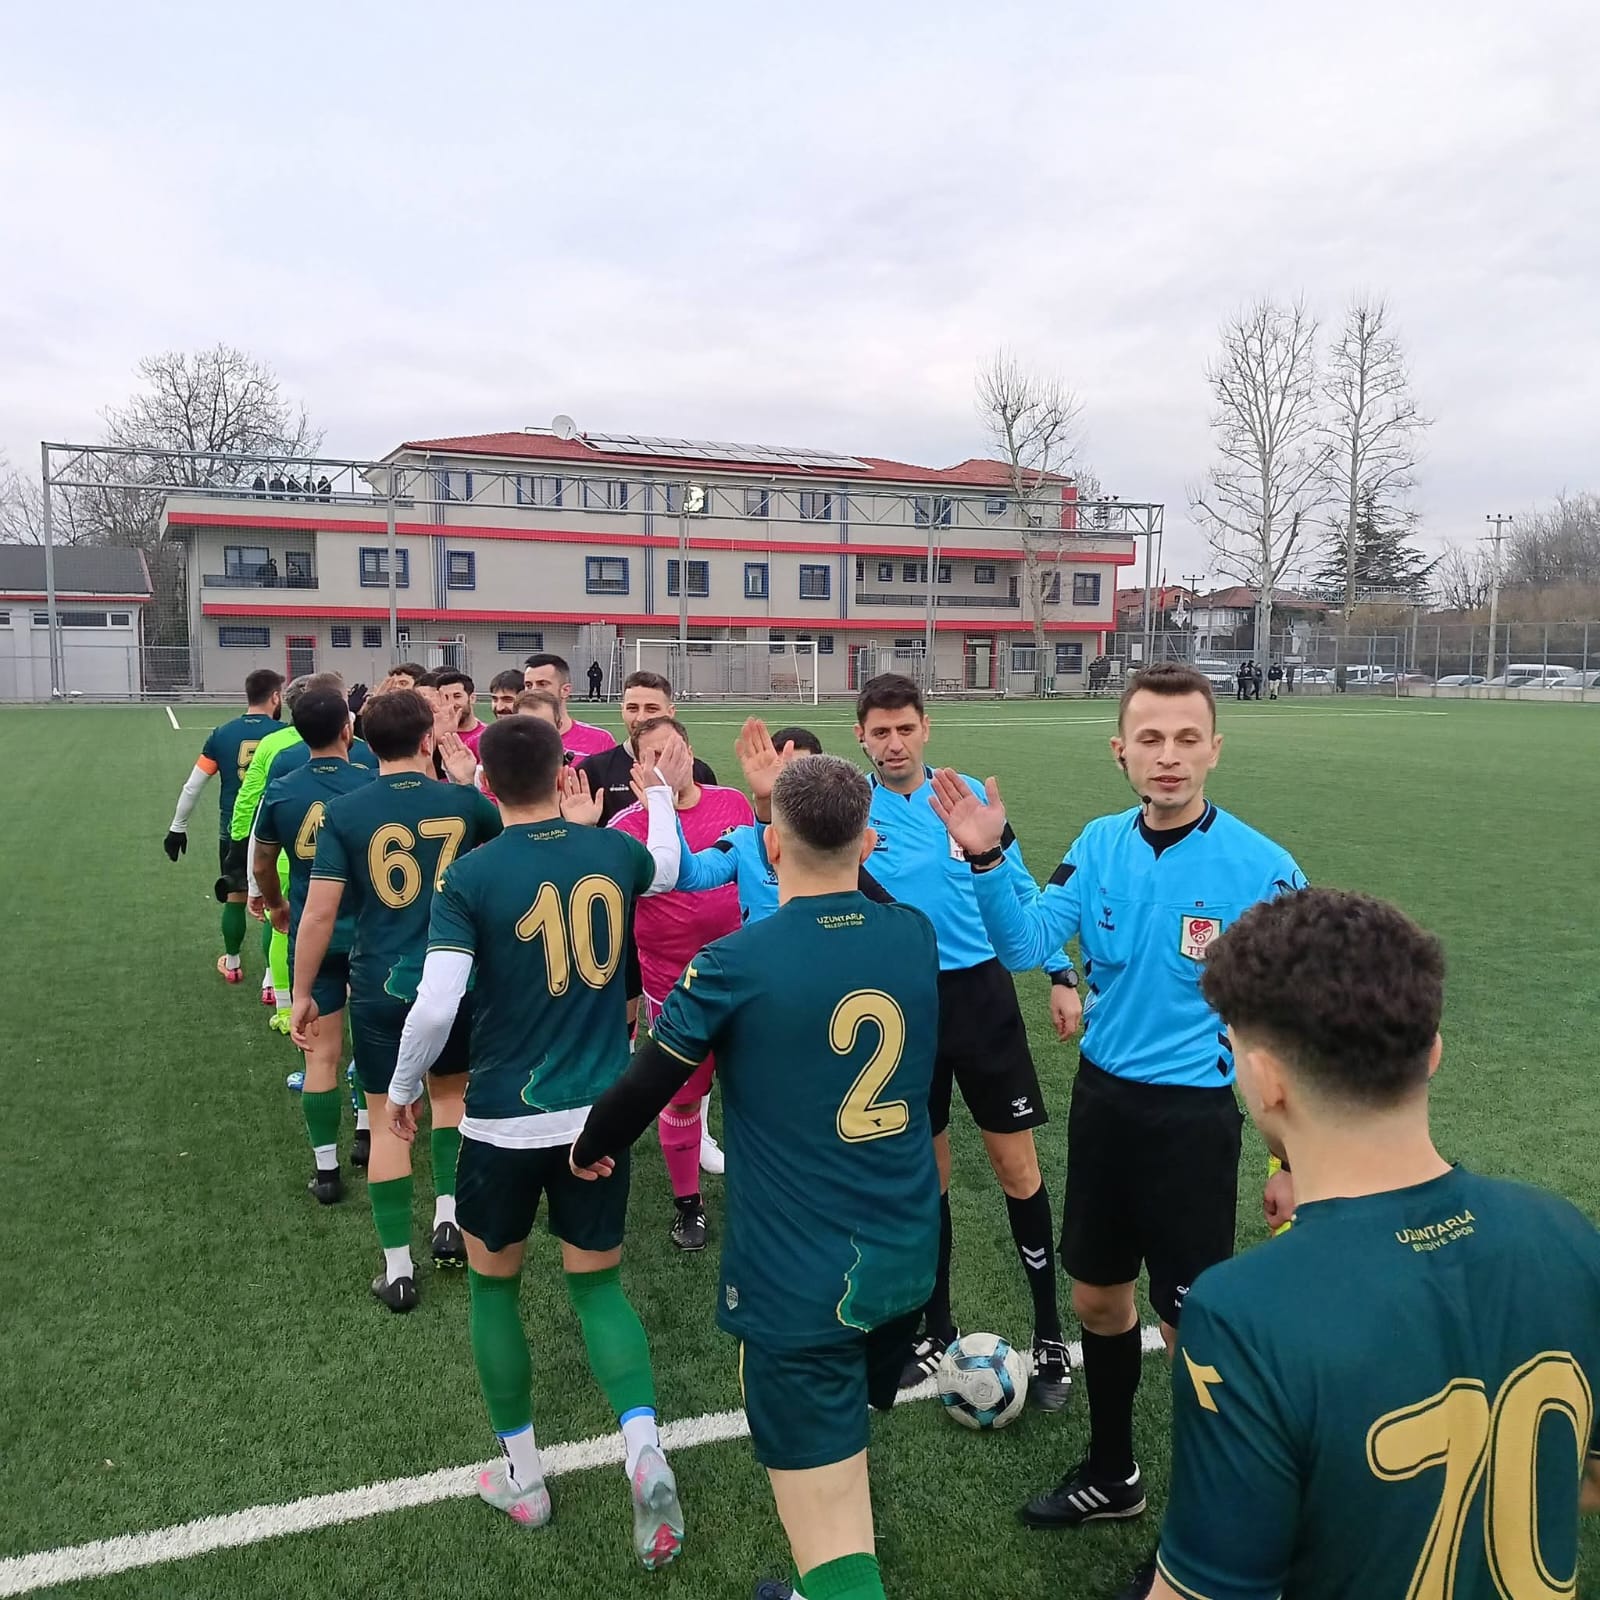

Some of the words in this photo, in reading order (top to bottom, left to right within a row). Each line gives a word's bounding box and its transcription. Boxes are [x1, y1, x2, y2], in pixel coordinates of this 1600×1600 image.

[236, 740, 261, 780] 5
[295, 801, 323, 860] 4
[368, 816, 466, 909] 67
[515, 873, 624, 998] 10
[1187, 945, 1208, 957] TF
[829, 988, 909, 1143] 2
[1448, 1226, 1475, 1240] SPOR
[1366, 1350, 1593, 1600] 70
